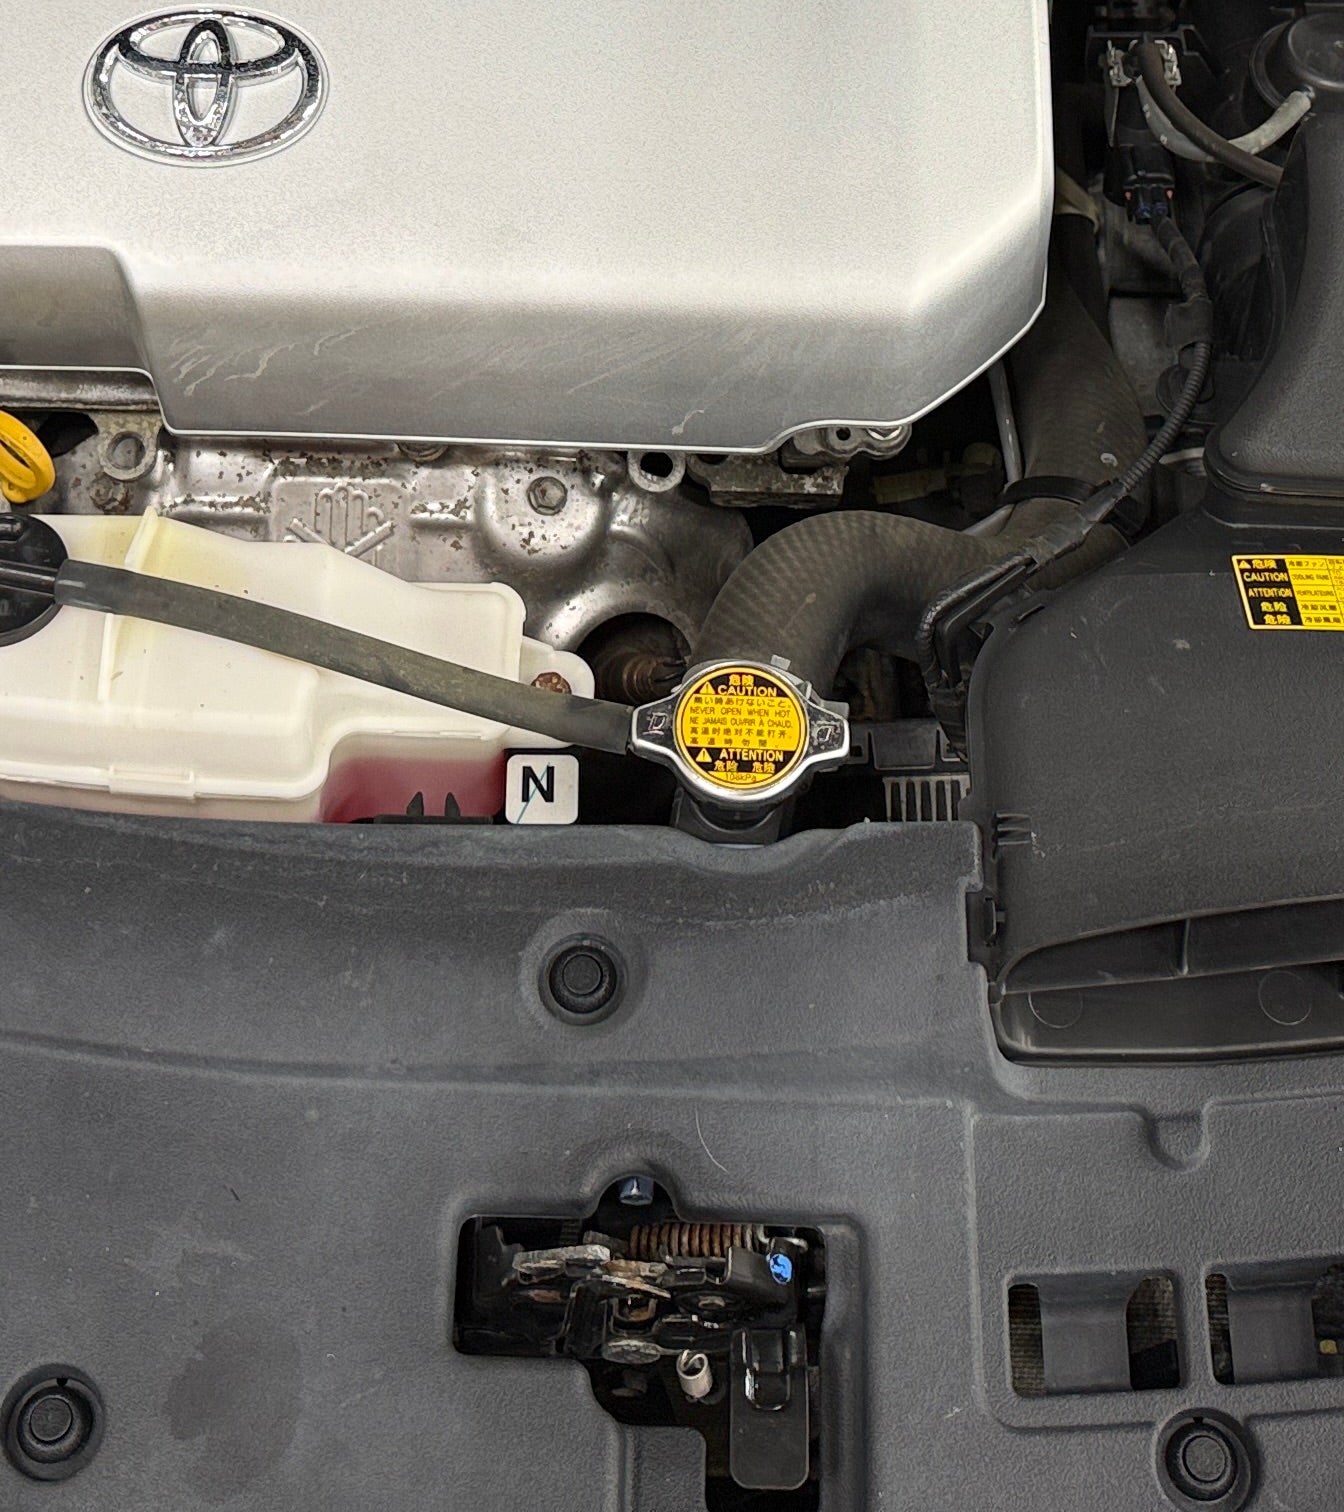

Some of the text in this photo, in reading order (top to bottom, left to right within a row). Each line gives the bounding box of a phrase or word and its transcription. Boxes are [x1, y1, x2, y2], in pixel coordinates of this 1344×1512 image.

[1243, 572, 1288, 582] CAUTION
[1249, 588, 1292, 597] ATTENTION
[718, 685, 777, 697] CAUTION
[747, 709, 769, 717] WHEN
[774, 710, 790, 718] HOT
[702, 717, 727, 725] JAMAIS
[731, 718, 755, 726] OUVRIR
[720, 749, 784, 762] ATTENTION
[522, 765, 555, 803] N
